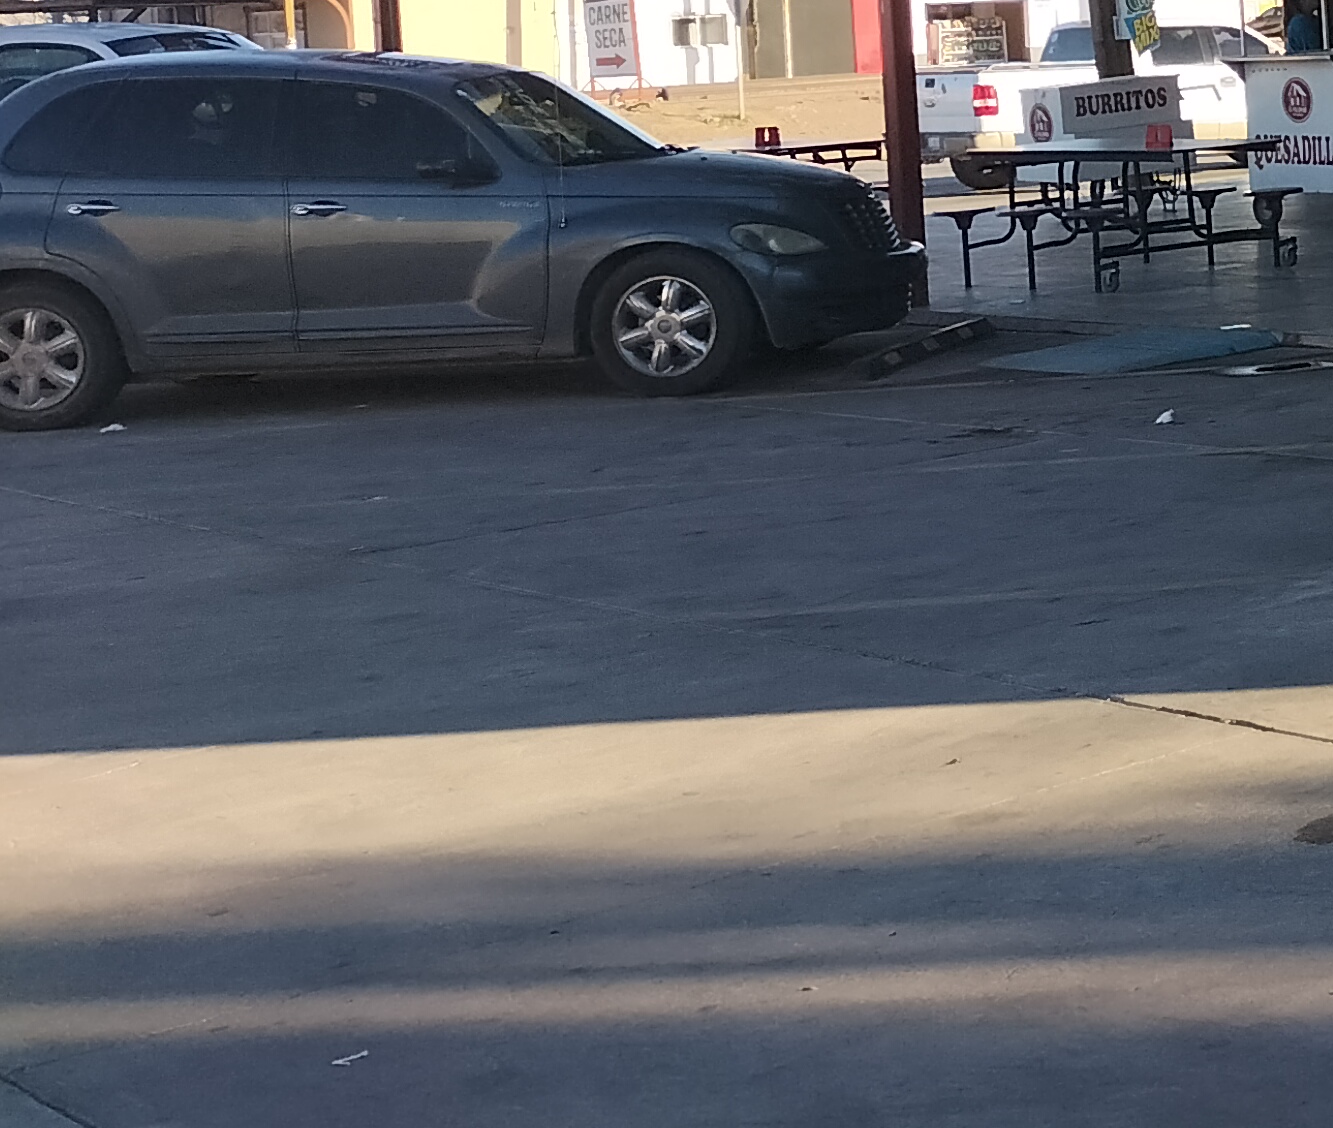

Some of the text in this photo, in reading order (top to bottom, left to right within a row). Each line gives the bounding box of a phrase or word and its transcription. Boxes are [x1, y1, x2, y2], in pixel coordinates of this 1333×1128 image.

[588, 3, 629, 26] CARNE
[595, 27, 626, 49] SECA
[1074, 86, 1168, 118] BURRITOS
